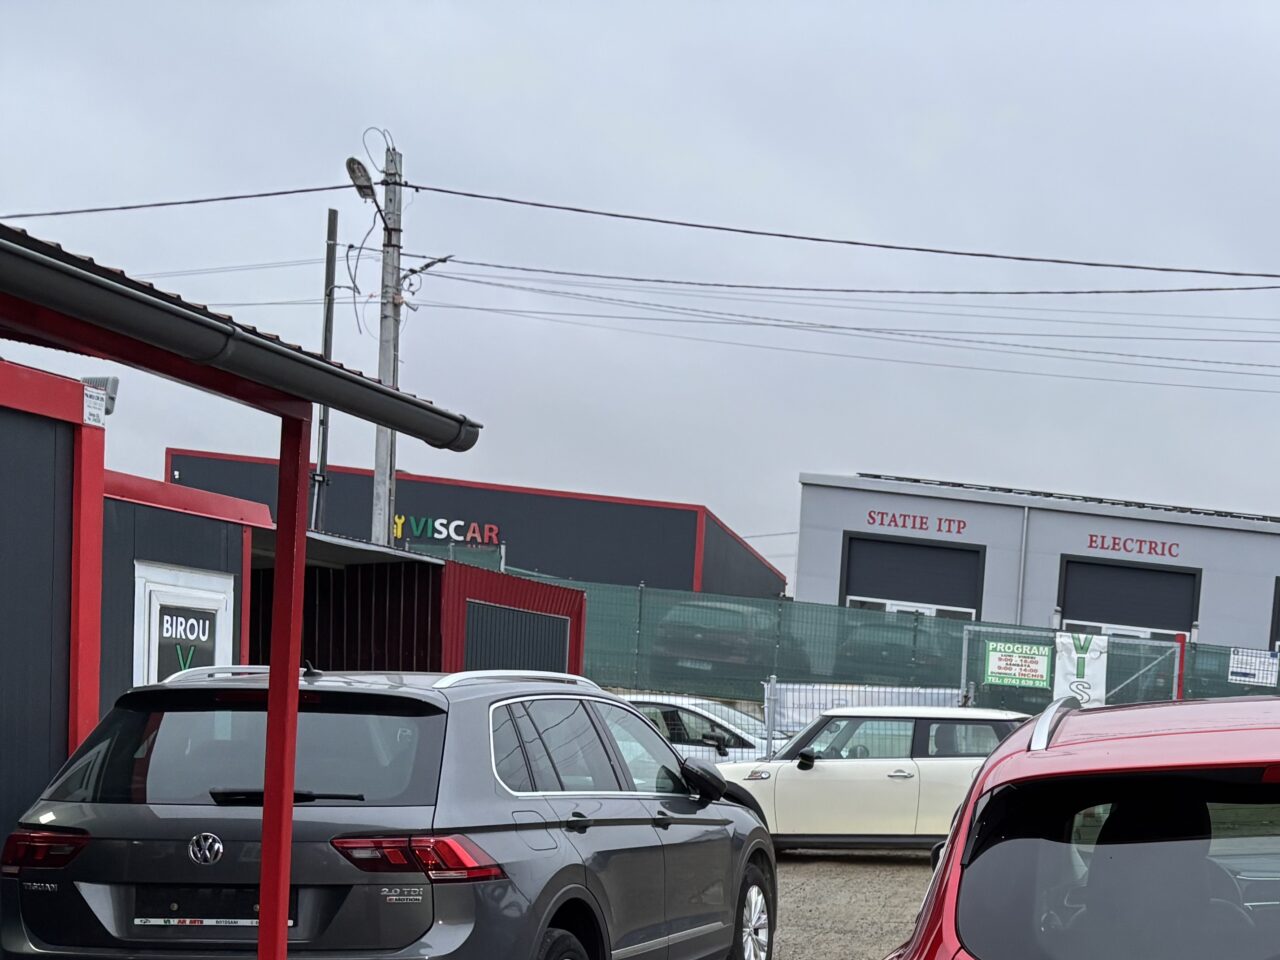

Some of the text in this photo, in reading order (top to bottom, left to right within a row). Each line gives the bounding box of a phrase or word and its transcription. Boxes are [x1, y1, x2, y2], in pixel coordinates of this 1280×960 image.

[409, 516, 499, 544] VISCAR
[867, 510, 967, 534] STATIE ITP
[1088, 533, 1180, 557] ELECTRIC
[163, 615, 209, 641] BIROU
[989, 642, 1049, 656] PROGRAM
